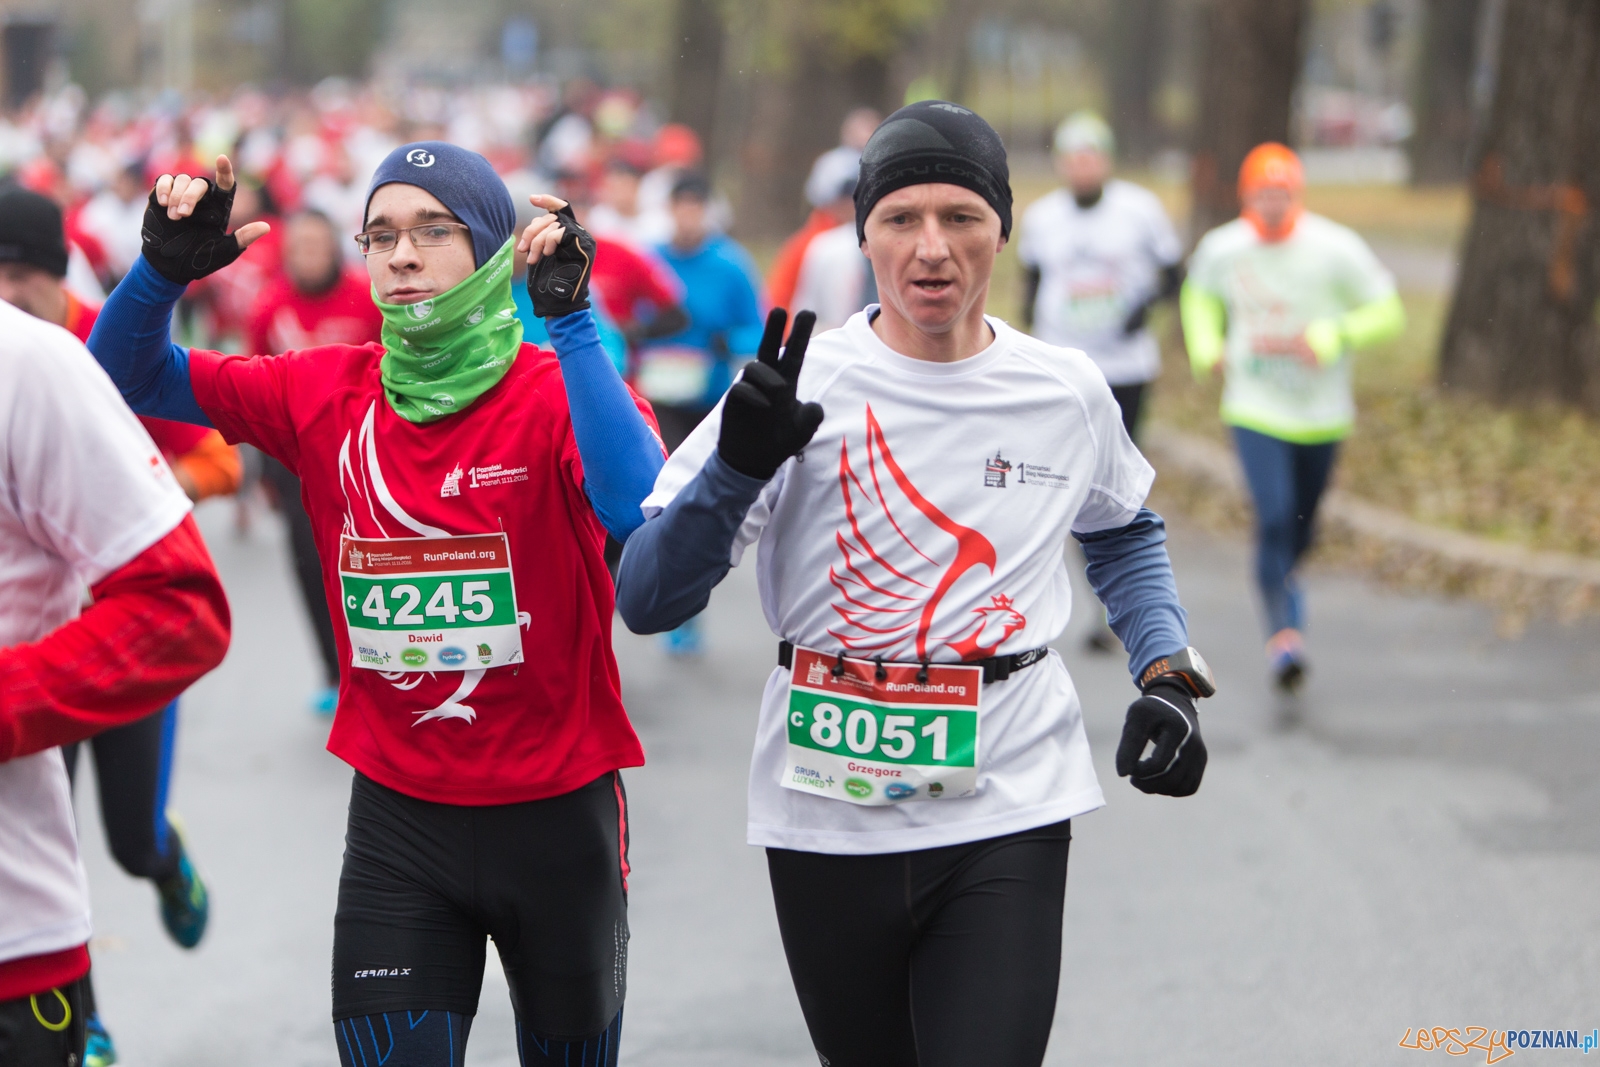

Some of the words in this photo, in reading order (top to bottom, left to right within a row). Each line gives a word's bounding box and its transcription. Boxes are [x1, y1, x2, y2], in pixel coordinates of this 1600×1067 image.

[468, 466, 480, 489] 1
[1017, 462, 1026, 484] 1
[366, 552, 374, 567] 1
[423, 550, 496, 563] RunPoland.org
[361, 580, 495, 625] 4245
[408, 633, 443, 643] Dawid
[358, 646, 379, 657] GRUPA
[360, 653, 384, 665] LUXMED
[886, 681, 966, 697] RunPoland.org
[810, 702, 949, 761] 8051
[794, 765, 821, 779] GRUPA
[847, 761, 902, 778] Grzegorz
[792, 774, 825, 789] LUXMED
[354, 968, 412, 978] CERMAX
